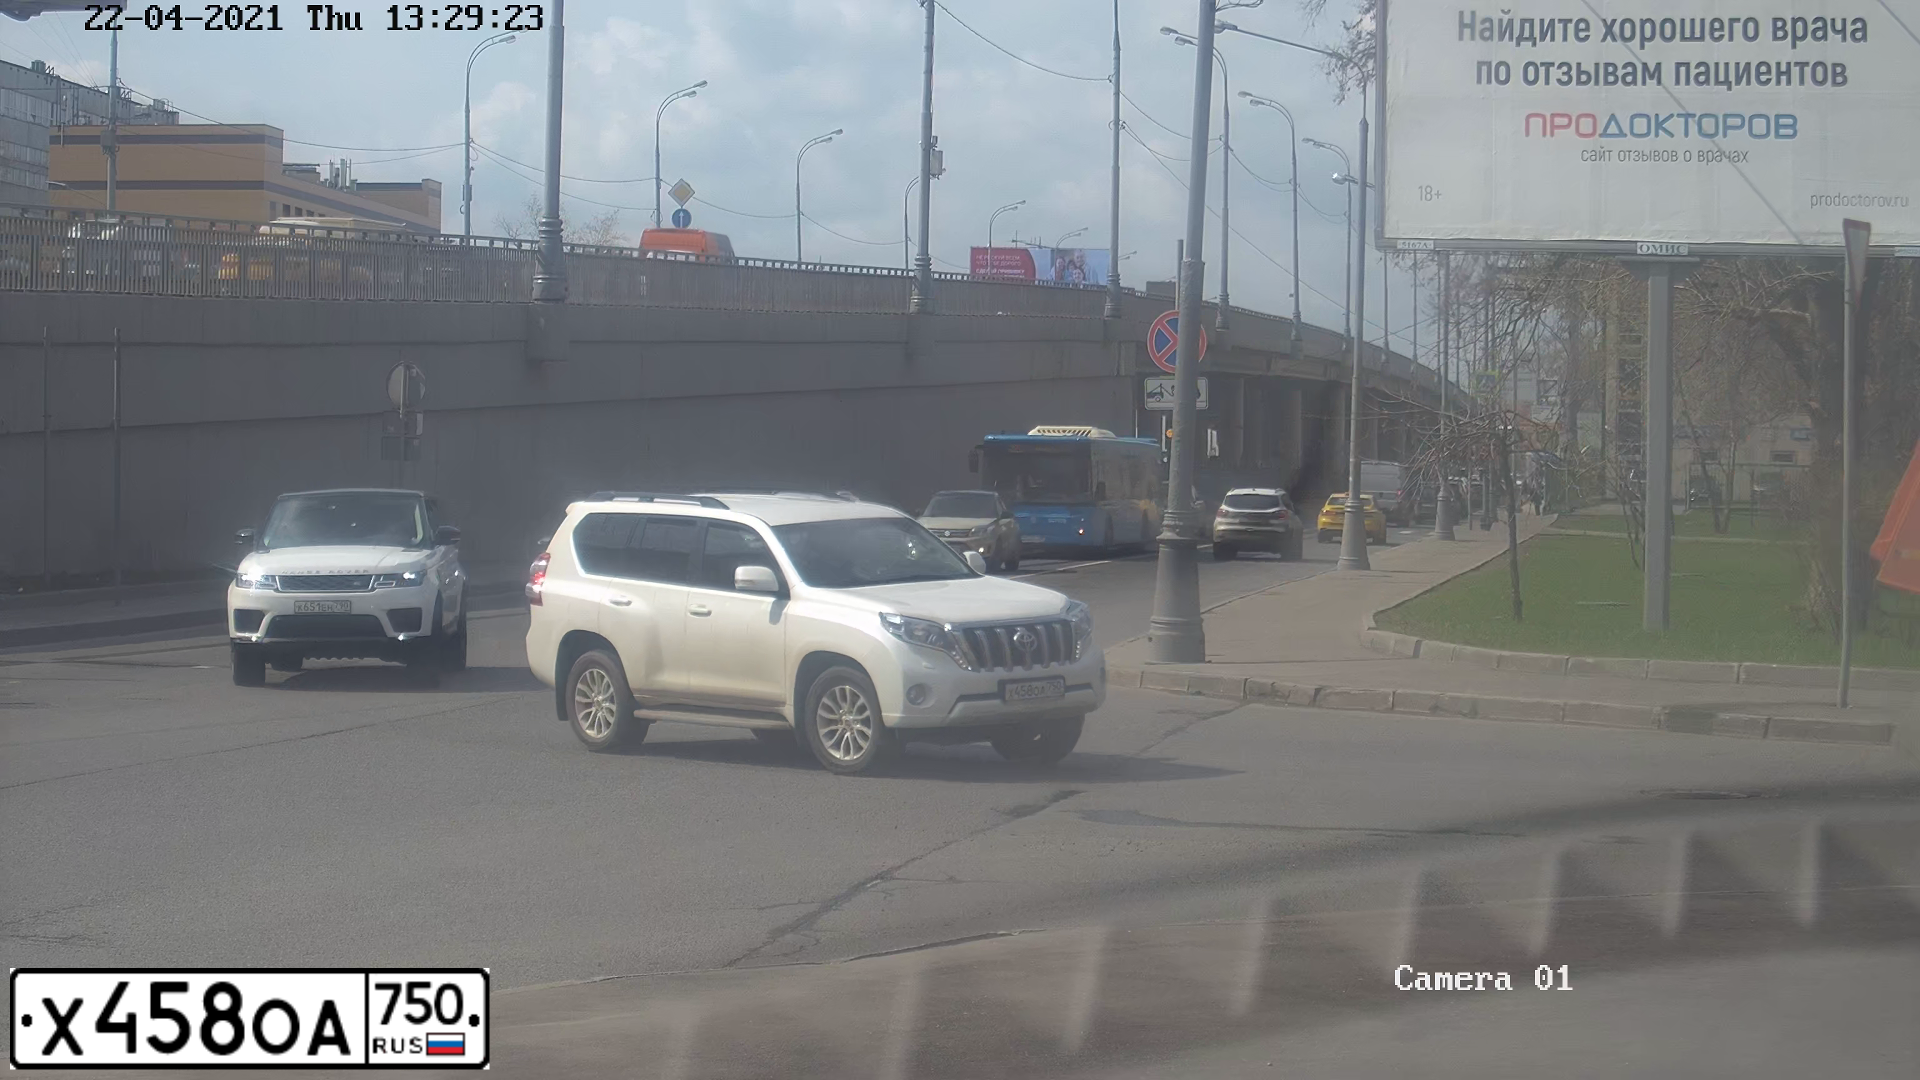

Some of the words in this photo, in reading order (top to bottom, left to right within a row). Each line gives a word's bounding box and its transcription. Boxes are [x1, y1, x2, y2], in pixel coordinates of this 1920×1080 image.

[1457, 10, 1591, 45] Найдите
[1602, 15, 1760, 49] хорошего
[1771, 18, 1868, 48] врача
[1476, 62, 1512, 86] по
[1521, 61, 1662, 87] отзывам
[1674, 62, 1848, 91] пациентов
[1524, 112, 1799, 140] ПРОДОКТОРОВ
[1580, 147, 1613, 163] сайт
[1617, 149, 1679, 163] отзывов
[1683, 151, 1692, 164] о
[1697, 150, 1749, 166] врачах
[1417, 185, 1443, 203] 18+
[1810, 192, 1909, 209] prodoctorov.ru
[1639, 243, 1687, 255] ОМИС
